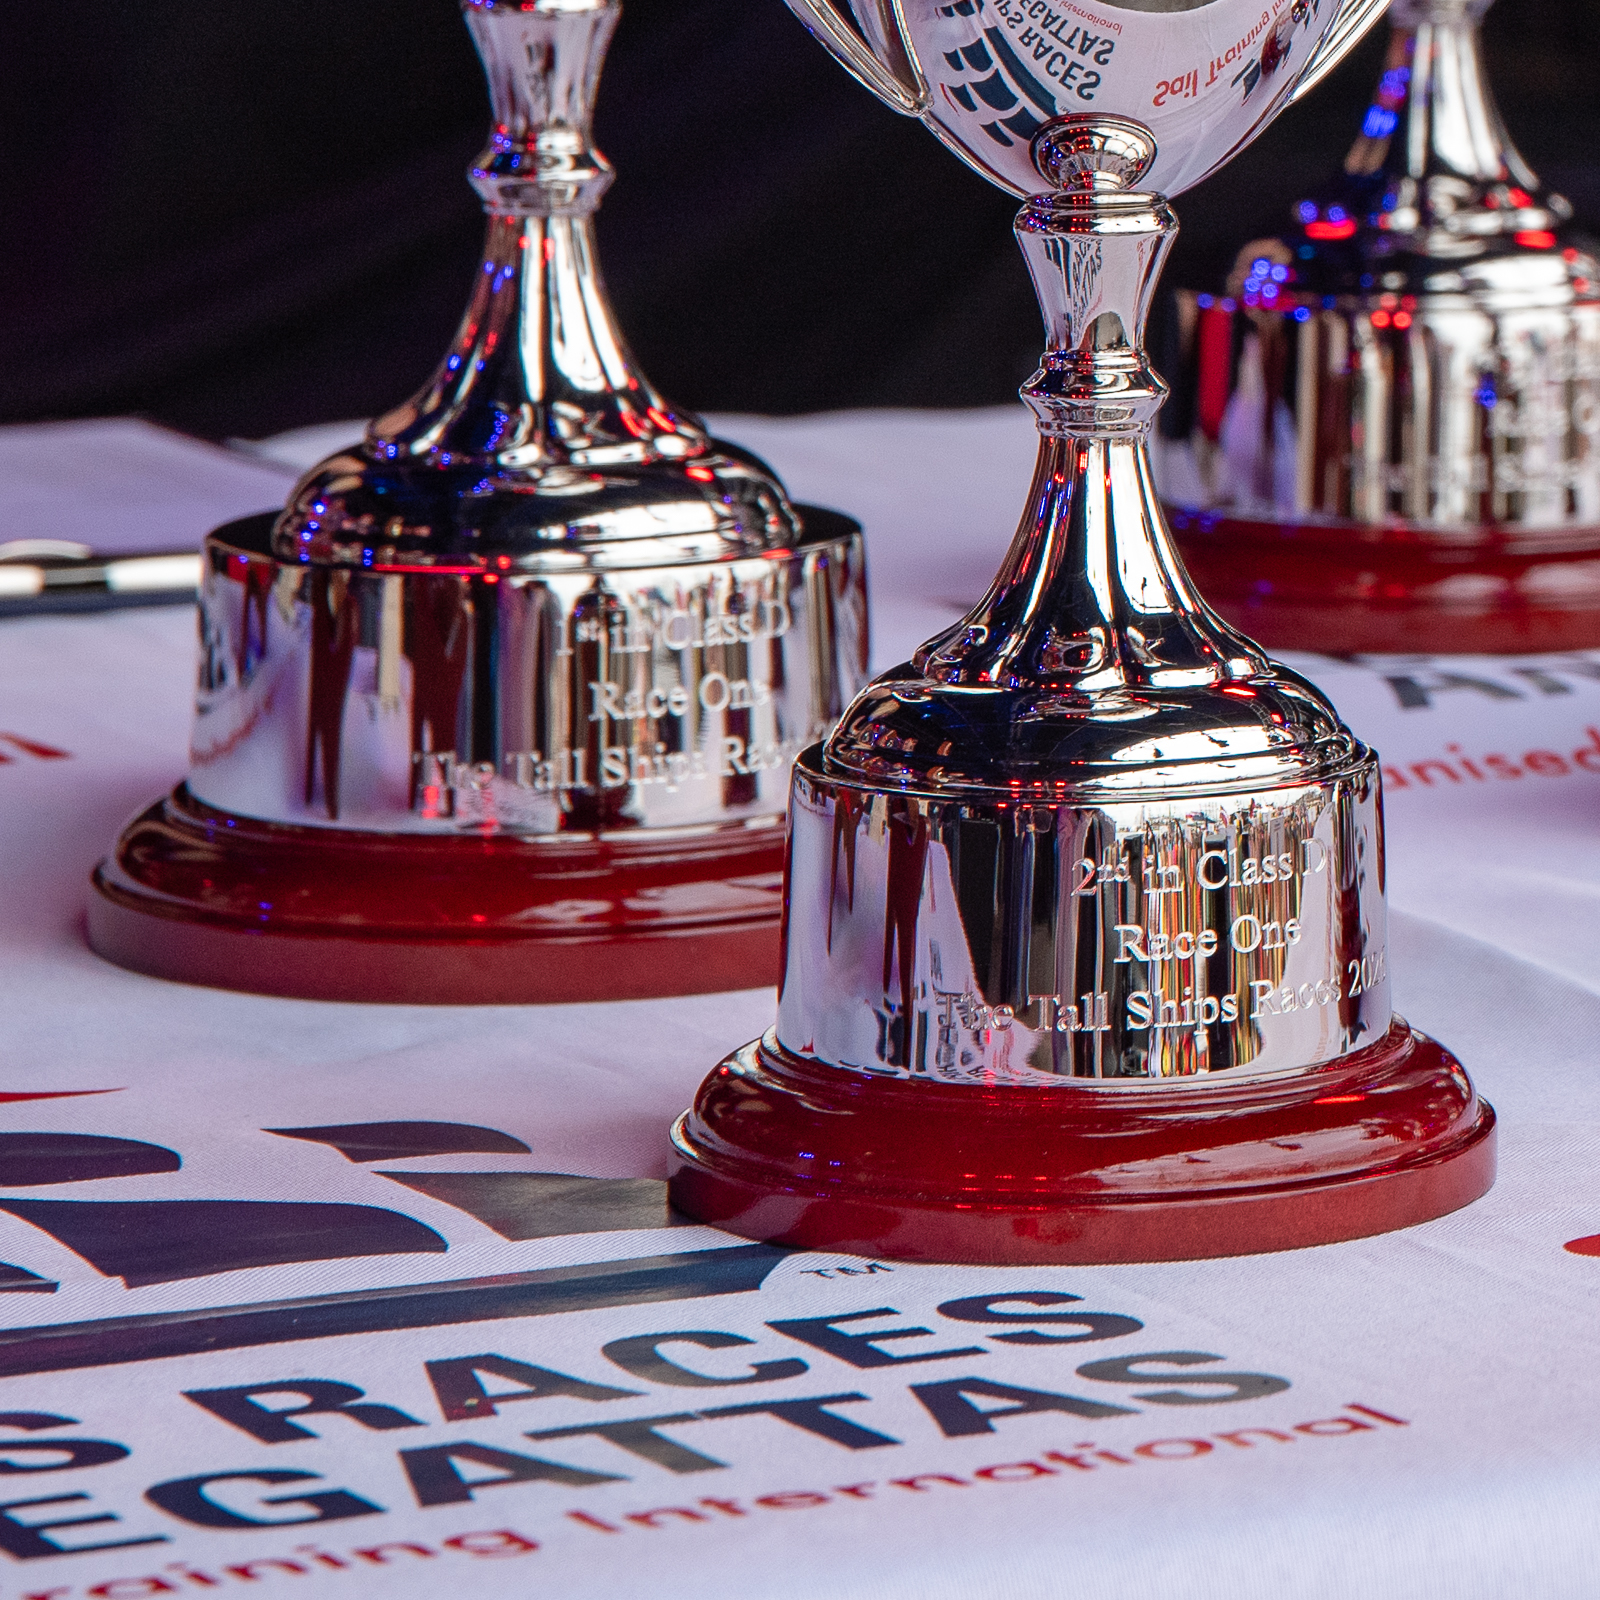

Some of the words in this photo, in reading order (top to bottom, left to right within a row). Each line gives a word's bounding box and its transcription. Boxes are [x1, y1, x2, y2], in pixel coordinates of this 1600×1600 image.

[662, 608, 756, 651] Class
[587, 679, 690, 722] Race
[698, 671, 774, 714] One
[505, 747, 593, 793] Tall
[1070, 855, 1131, 899] 2nd
[1143, 854, 1183, 896] in
[1197, 844, 1294, 892] Class
[1300, 836, 1328, 877] D
[1112, 921, 1219, 965] Race
[1229, 912, 1302, 955] One
[933, 990, 1015, 1033] The
[1026, 990, 1113, 1034] Tall
[1125, 988, 1240, 1036] Ships
[1248, 973, 1342, 1020] Races
[800, 1261, 895, 1280] TM
[179, 1289, 1145, 1445] RACES
[564, 1402, 1411, 1534] International
